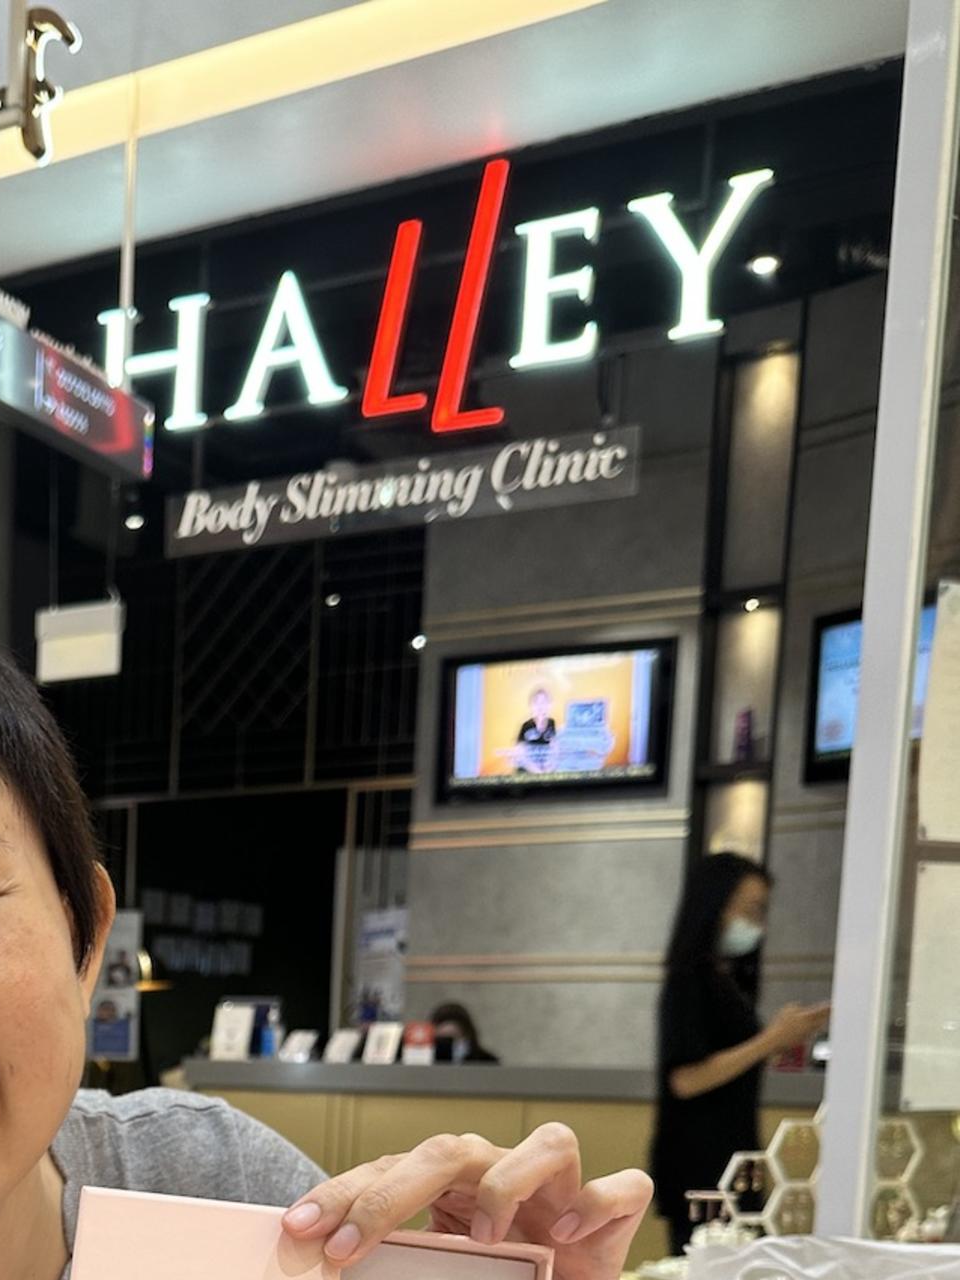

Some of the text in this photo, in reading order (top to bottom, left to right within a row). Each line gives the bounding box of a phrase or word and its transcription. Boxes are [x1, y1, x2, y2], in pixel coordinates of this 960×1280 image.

[97, 158, 775, 433] HALLEY
[175, 432, 628, 545] Body Slimming Clinic
